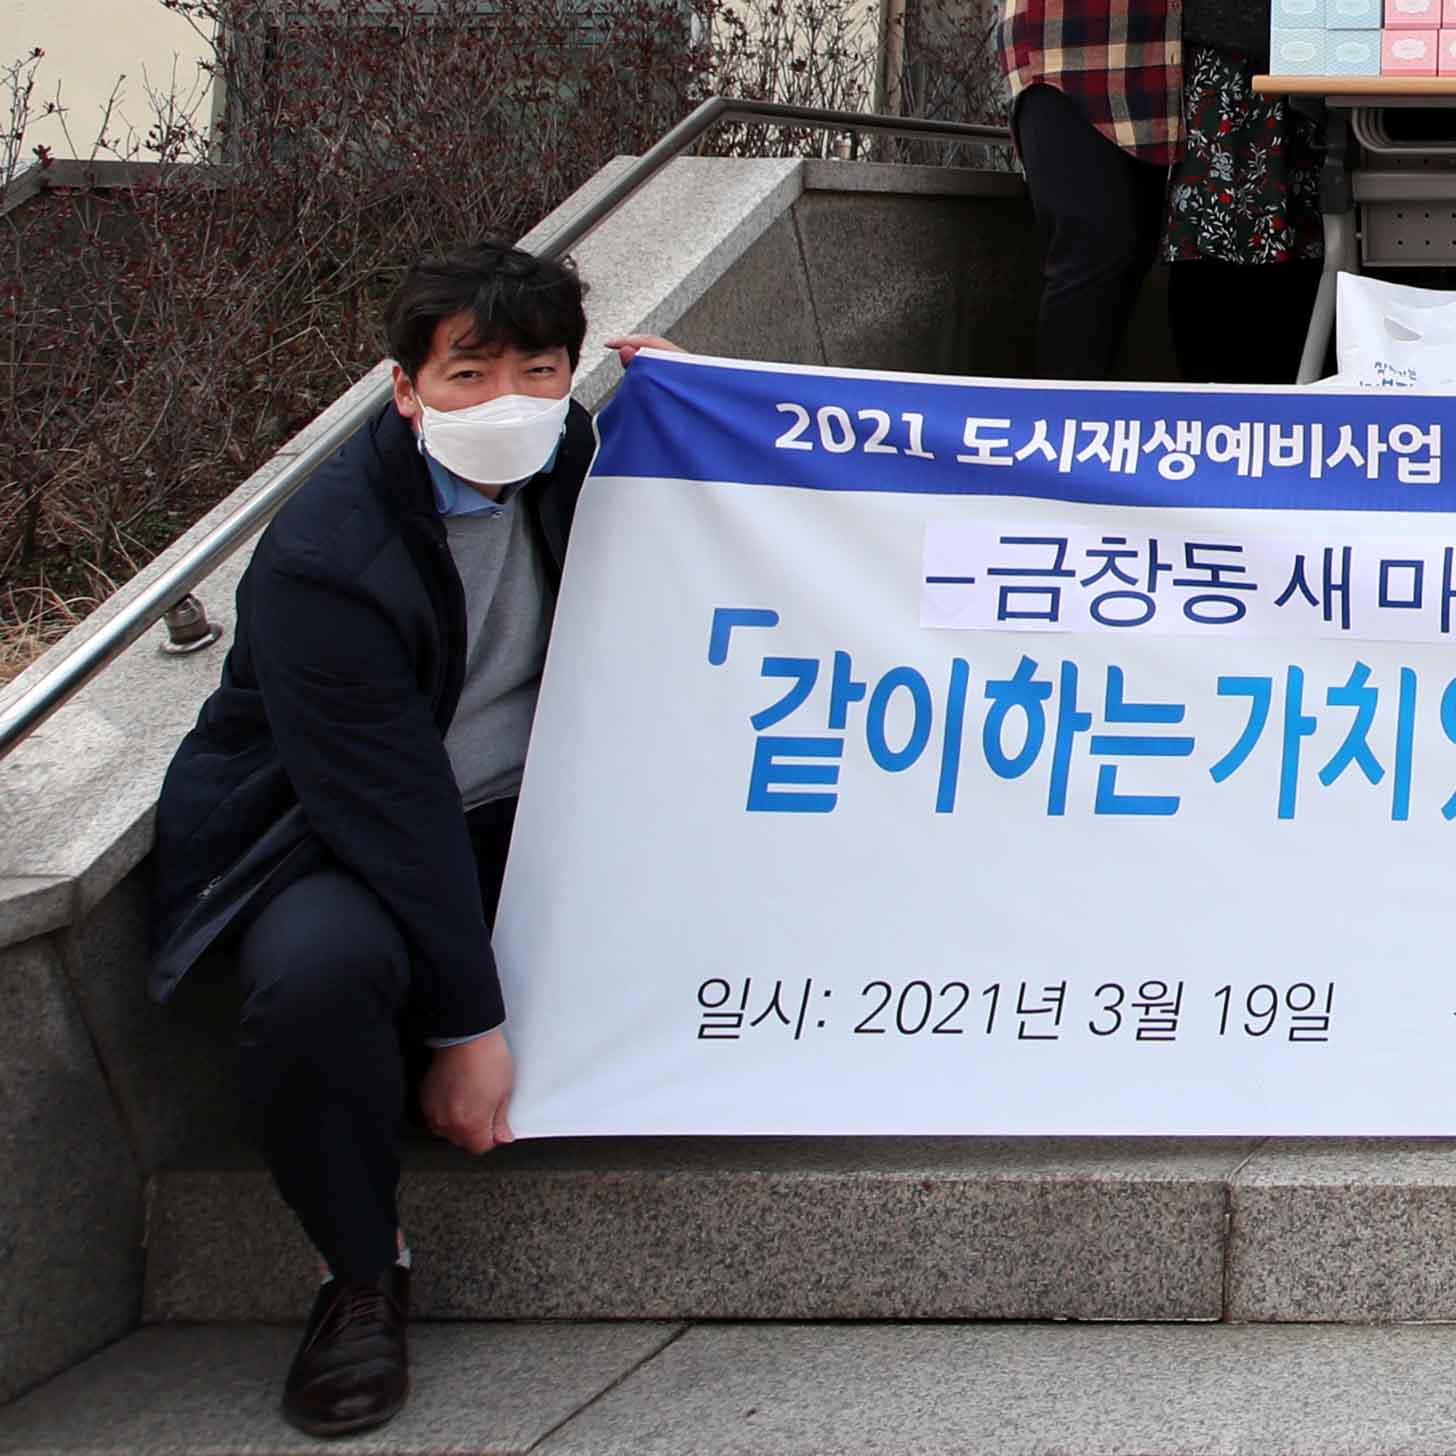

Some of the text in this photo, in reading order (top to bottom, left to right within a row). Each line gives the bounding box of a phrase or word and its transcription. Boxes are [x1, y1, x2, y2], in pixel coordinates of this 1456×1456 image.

[776, 403, 934, 460] 2021
[956, 417, 1441, 486] 도시재생예비사업
[696, 977, 832, 1042] 일시:
[853, 979, 1067, 1042] 2021년
[1088, 980, 1185, 1042] 3월
[1213, 981, 1335, 1043] 19일
